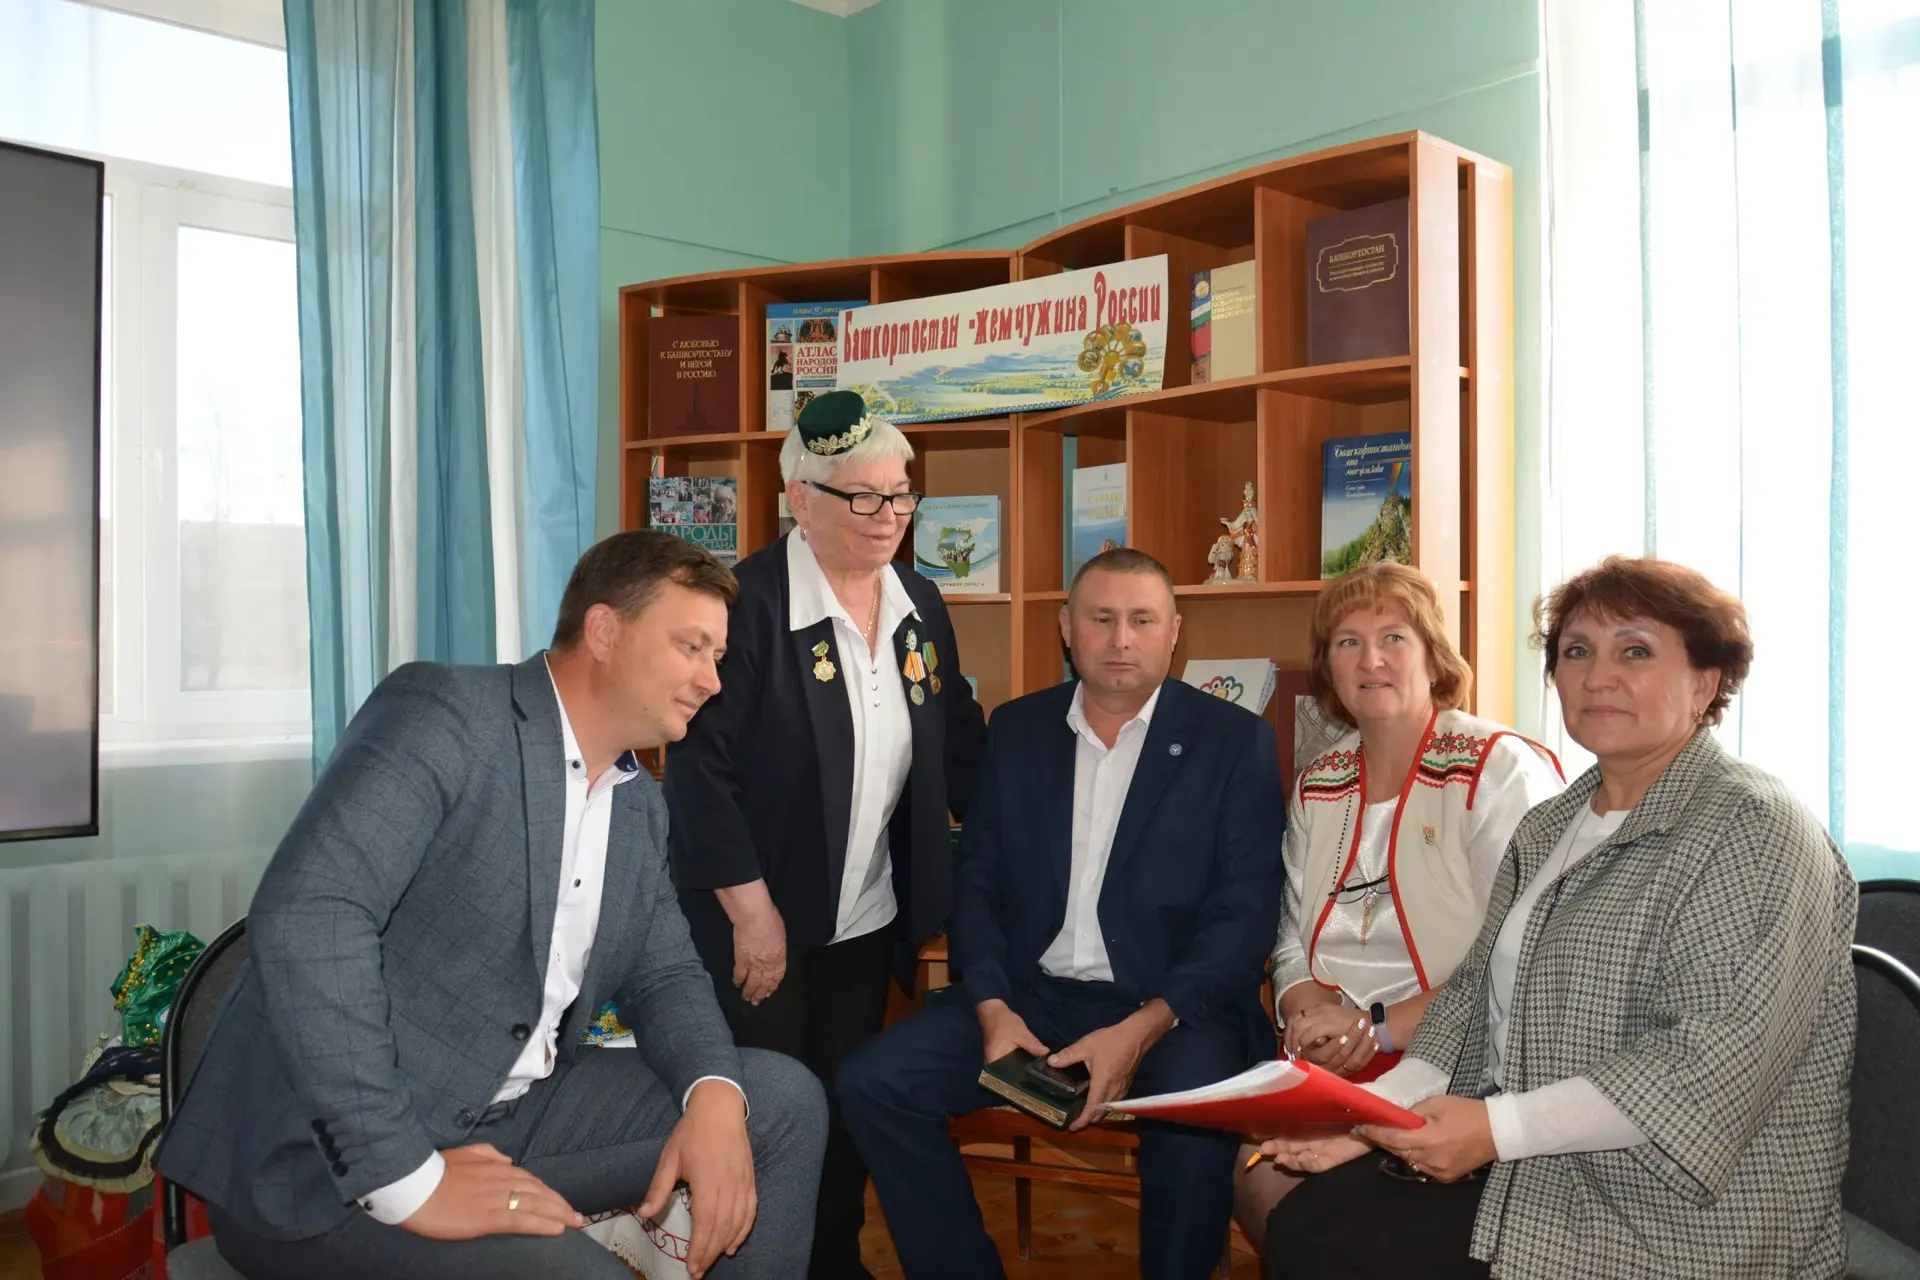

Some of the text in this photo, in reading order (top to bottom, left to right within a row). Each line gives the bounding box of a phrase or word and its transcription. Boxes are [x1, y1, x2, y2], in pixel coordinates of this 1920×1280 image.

[1329, 244, 1385, 263] БАШКОРТОСТАН
[843, 310, 960, 365] Башкортостан
[1093, 271, 1161, 336] России
[672, 339, 720, 349] С ЛЮБОВЬЮ
[660, 349, 732, 359] К БАШКОРТОСТАНУ
[797, 345, 837, 358] АТЛАС
[680, 359, 712, 369] И ВЕРОЙ
[796, 357, 837, 367] НАРОДОВ
[676, 369, 717, 379] В РОССИЮ
[796, 365, 837, 376] РОССИИ
